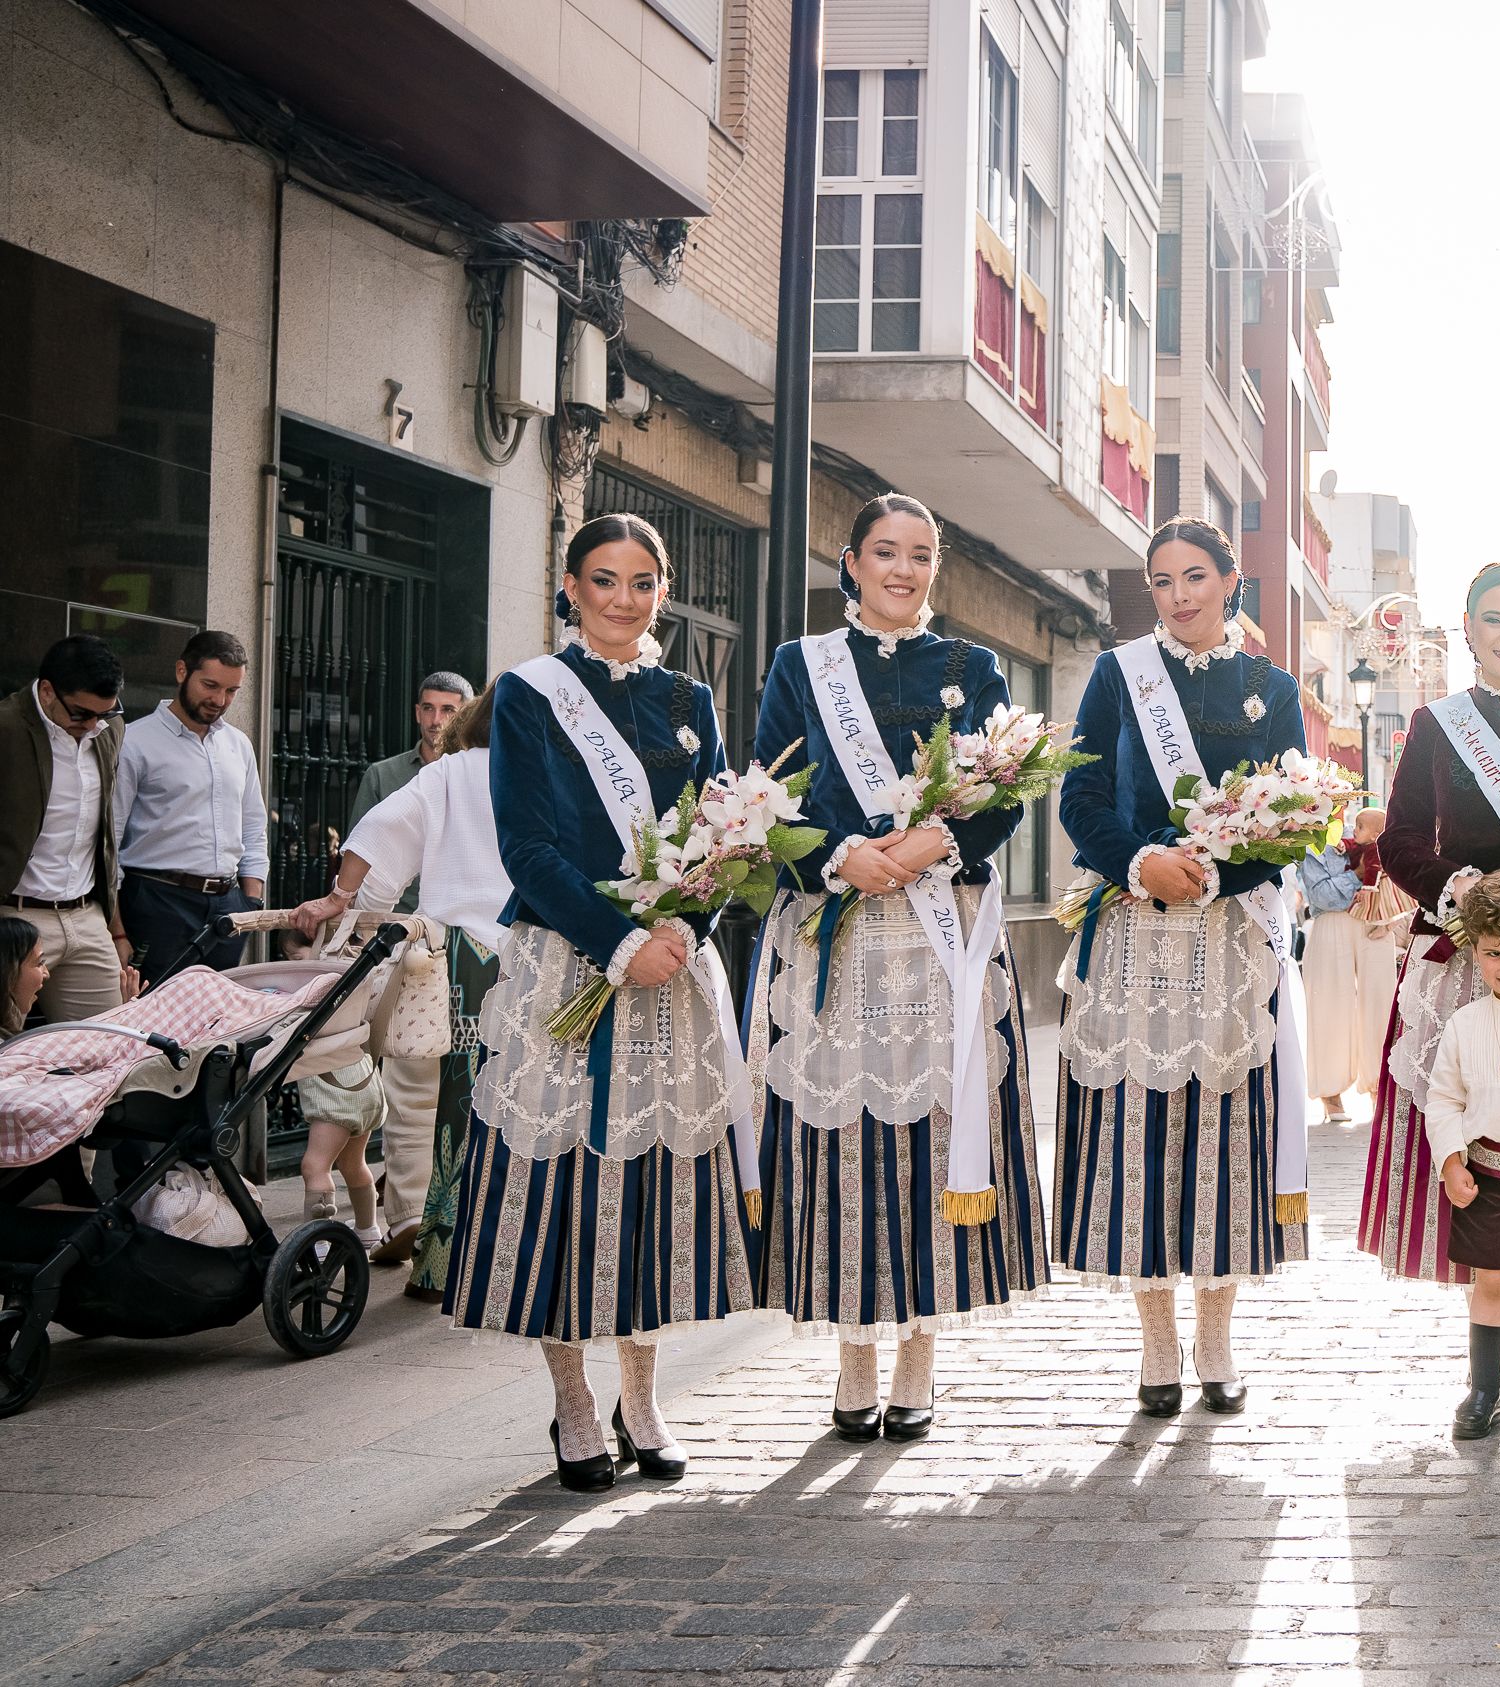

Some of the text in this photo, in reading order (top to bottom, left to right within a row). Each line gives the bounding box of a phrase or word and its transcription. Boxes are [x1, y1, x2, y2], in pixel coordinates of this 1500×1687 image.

[397, 408, 413, 440] 7
[828, 681, 886, 792] DAMA DE
[1149, 705, 1184, 767] DAMA
[584, 731, 638, 804] DAMA
[1266, 916, 1288, 955] 2026
